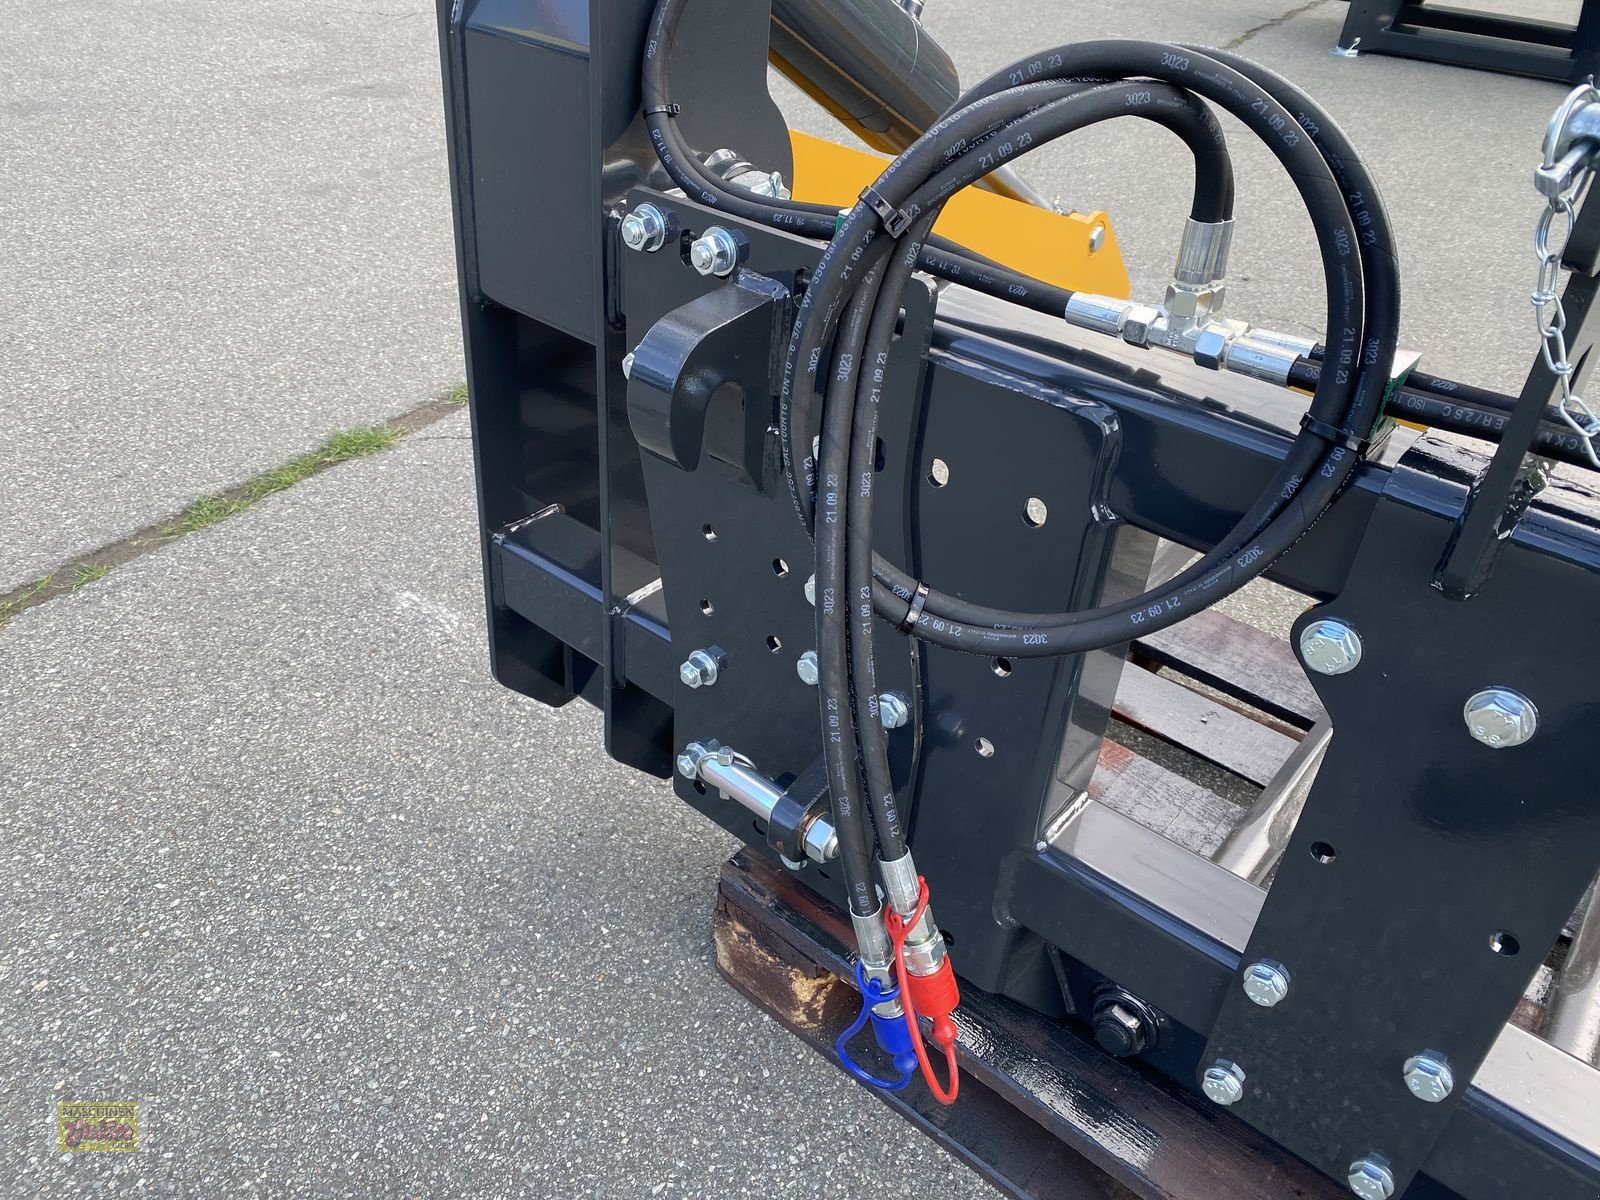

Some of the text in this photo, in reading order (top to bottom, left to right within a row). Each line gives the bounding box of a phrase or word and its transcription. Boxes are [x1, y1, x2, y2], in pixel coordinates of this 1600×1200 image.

[978, 132, 1033, 170] 21.09.23
[870, 352, 888, 403] 21.09.23
[1407, 397, 1427, 412] ISO
[826, 473, 839, 524] 21.09.23
[860, 586, 872, 636] 21.09.23
[1130, 596, 1181, 625] 21.09.23
[827, 698, 841, 743] 21.09.23
